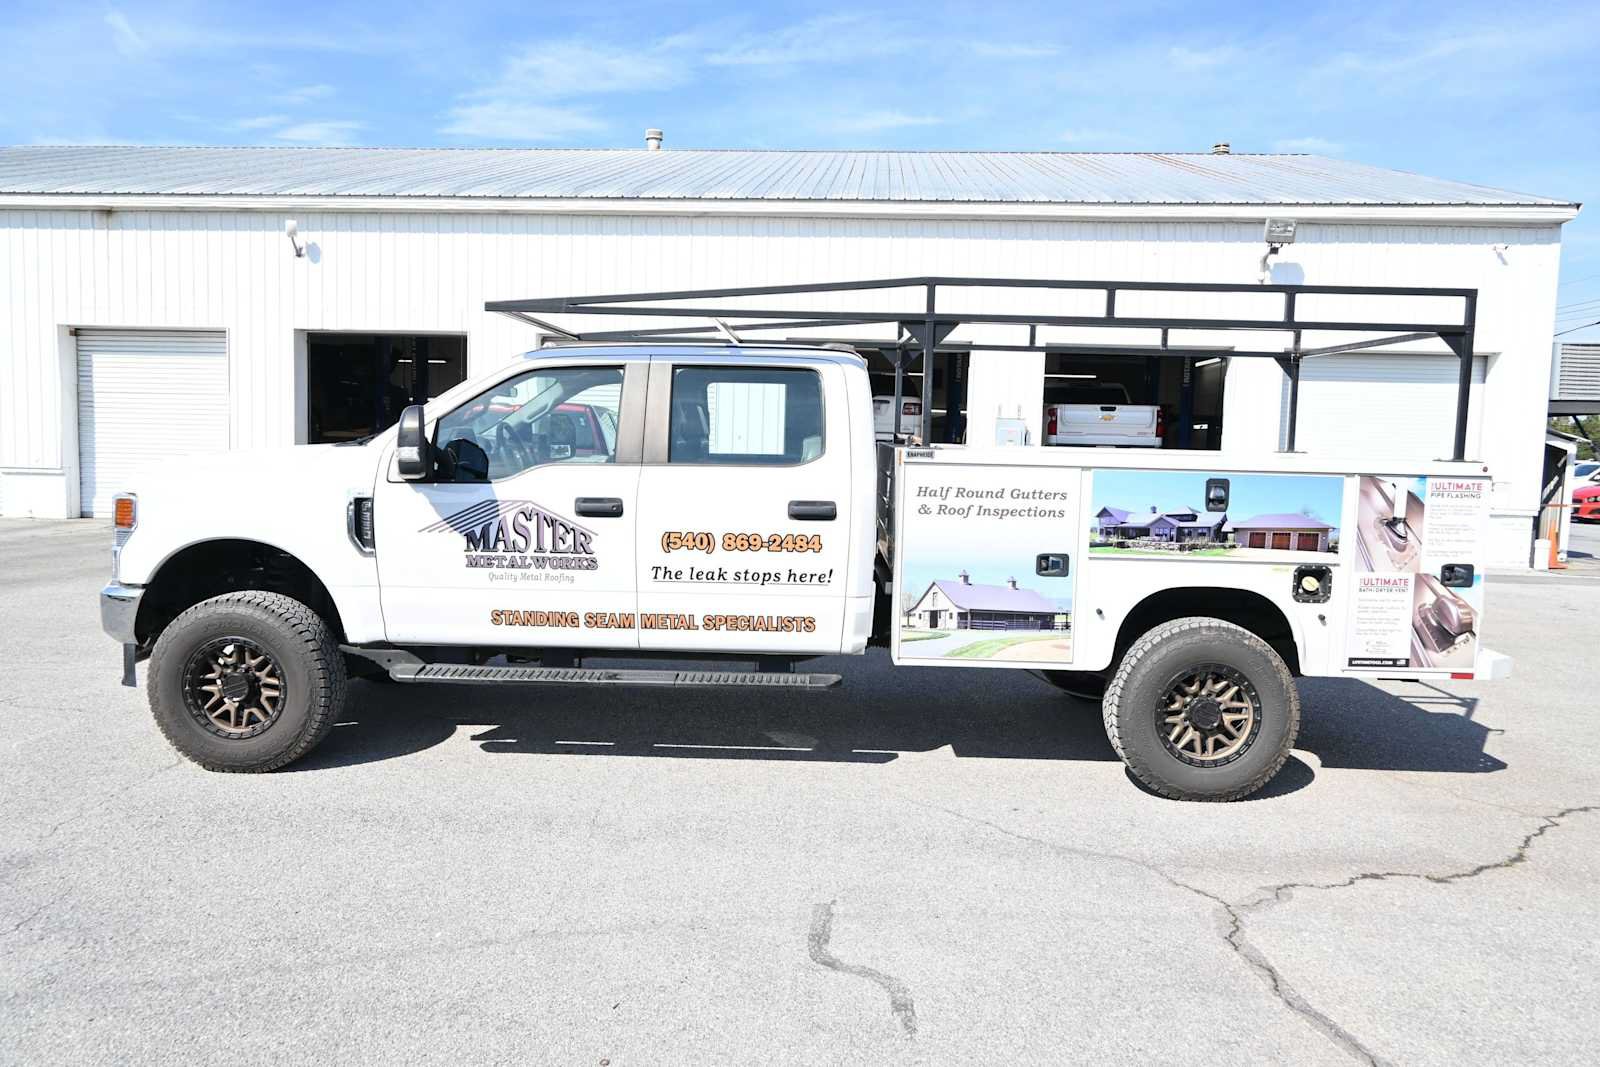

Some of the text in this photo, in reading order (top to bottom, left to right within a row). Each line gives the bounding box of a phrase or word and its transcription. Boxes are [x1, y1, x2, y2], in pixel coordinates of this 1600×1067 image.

[916, 486, 1068, 501] Half Round Gutters
[1435, 482, 1483, 491] ULTIMATE
[917, 503, 1065, 520] & Roof Inspections
[463, 506, 595, 554] MASTER
[661, 531, 823, 554] (540) 869-2484
[465, 554, 599, 571] METALWORKS
[488, 572, 575, 584] Quality Metal Roofing
[651, 566, 834, 585] The leak stops here!
[1363, 577, 1409, 586] ULTIMATE
[490, 608, 817, 633] STANDING SEAM METAL SPECIALISTS
